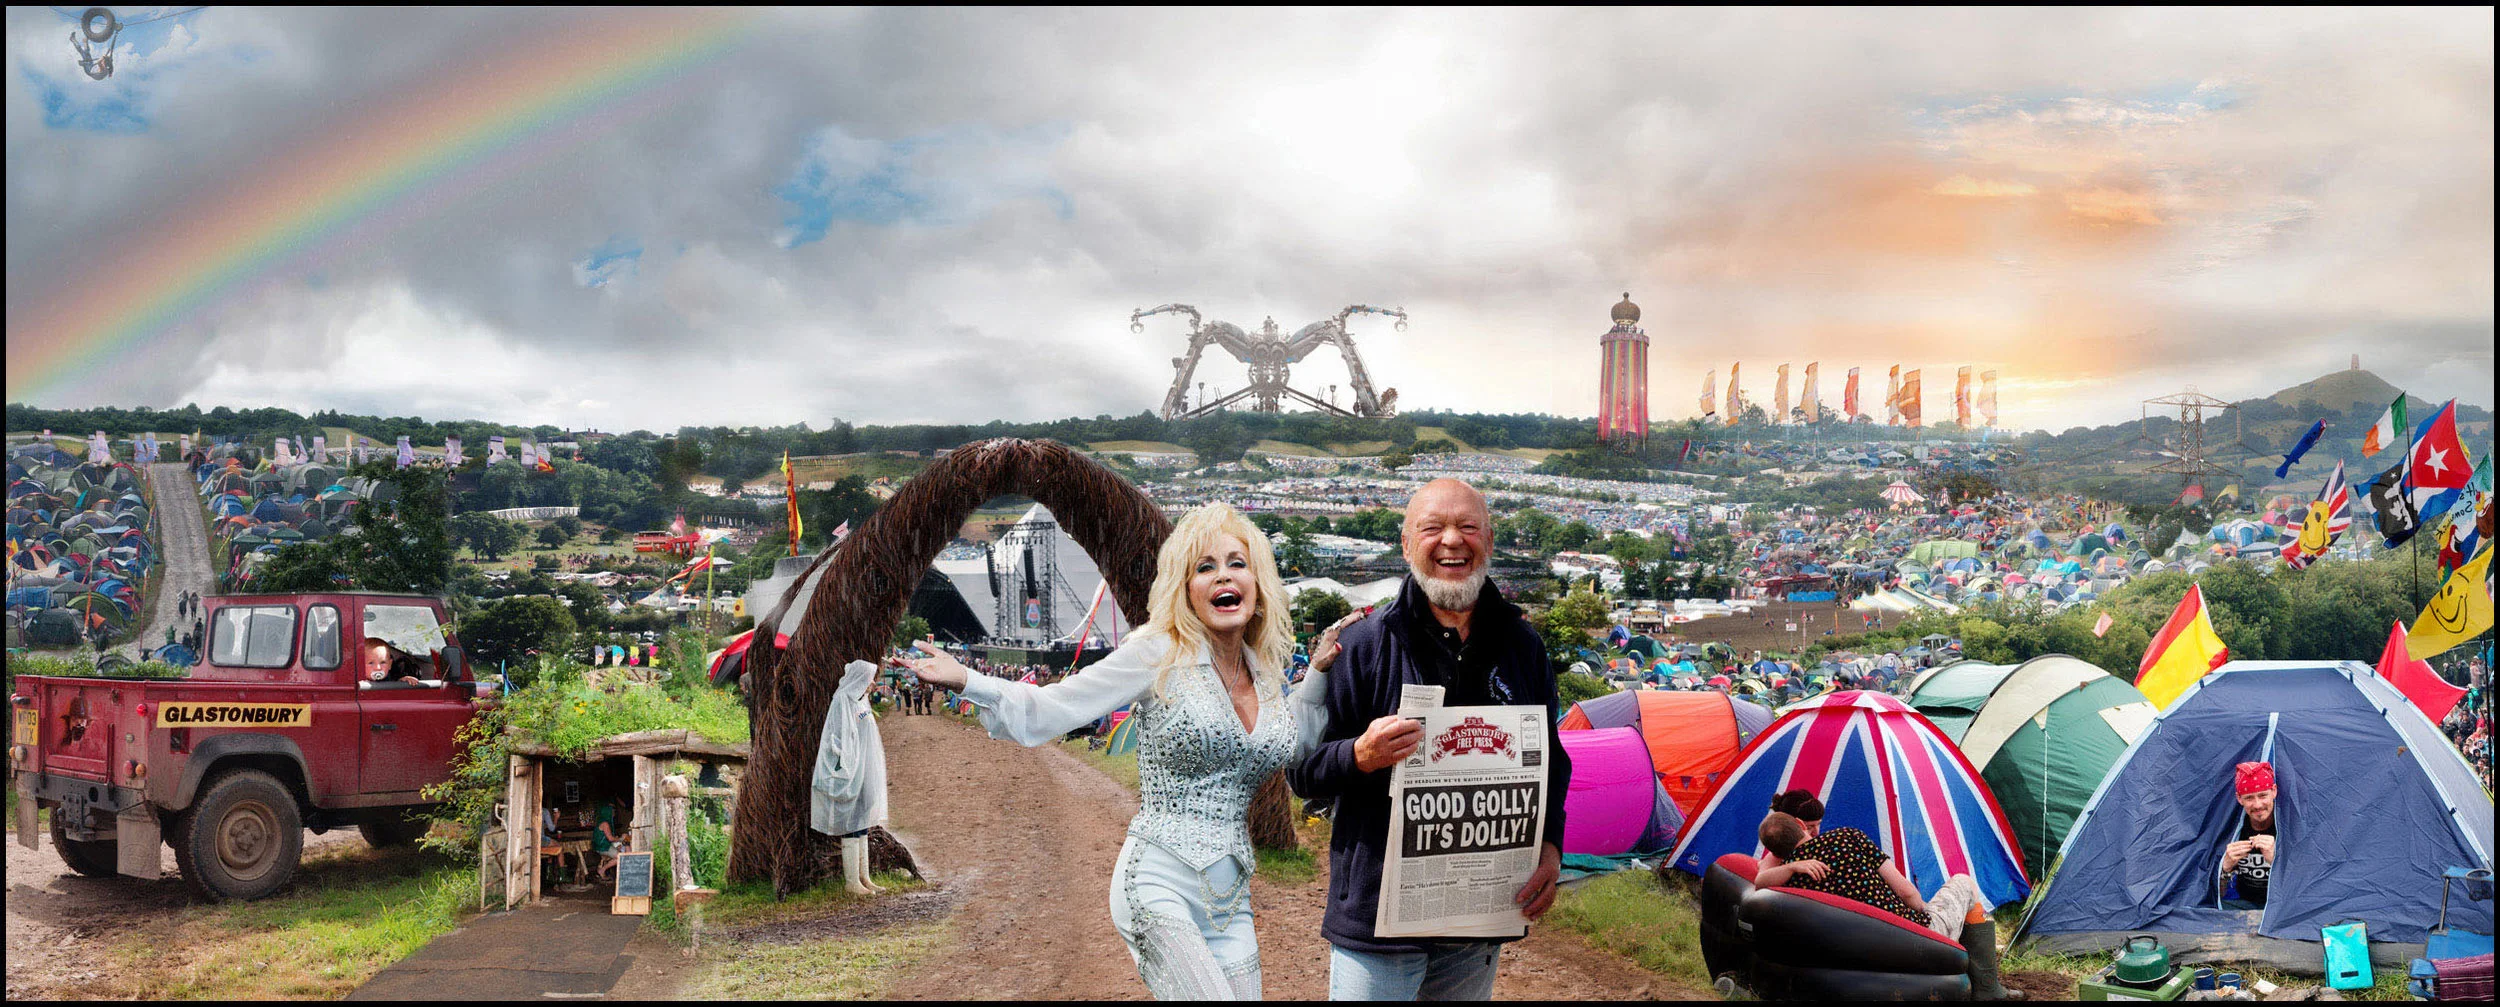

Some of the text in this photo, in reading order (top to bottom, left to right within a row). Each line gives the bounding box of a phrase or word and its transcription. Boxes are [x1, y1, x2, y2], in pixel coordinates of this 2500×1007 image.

[165, 706, 303, 723] GLASTONBURY
[1442, 728, 1506, 743] GLASTONBURY
[1457, 737, 1494, 749] FREE PRESS
[1406, 788, 1537, 821] GOOD GOLLY,
[1416, 818, 1529, 851] IT'S DOLLY!
